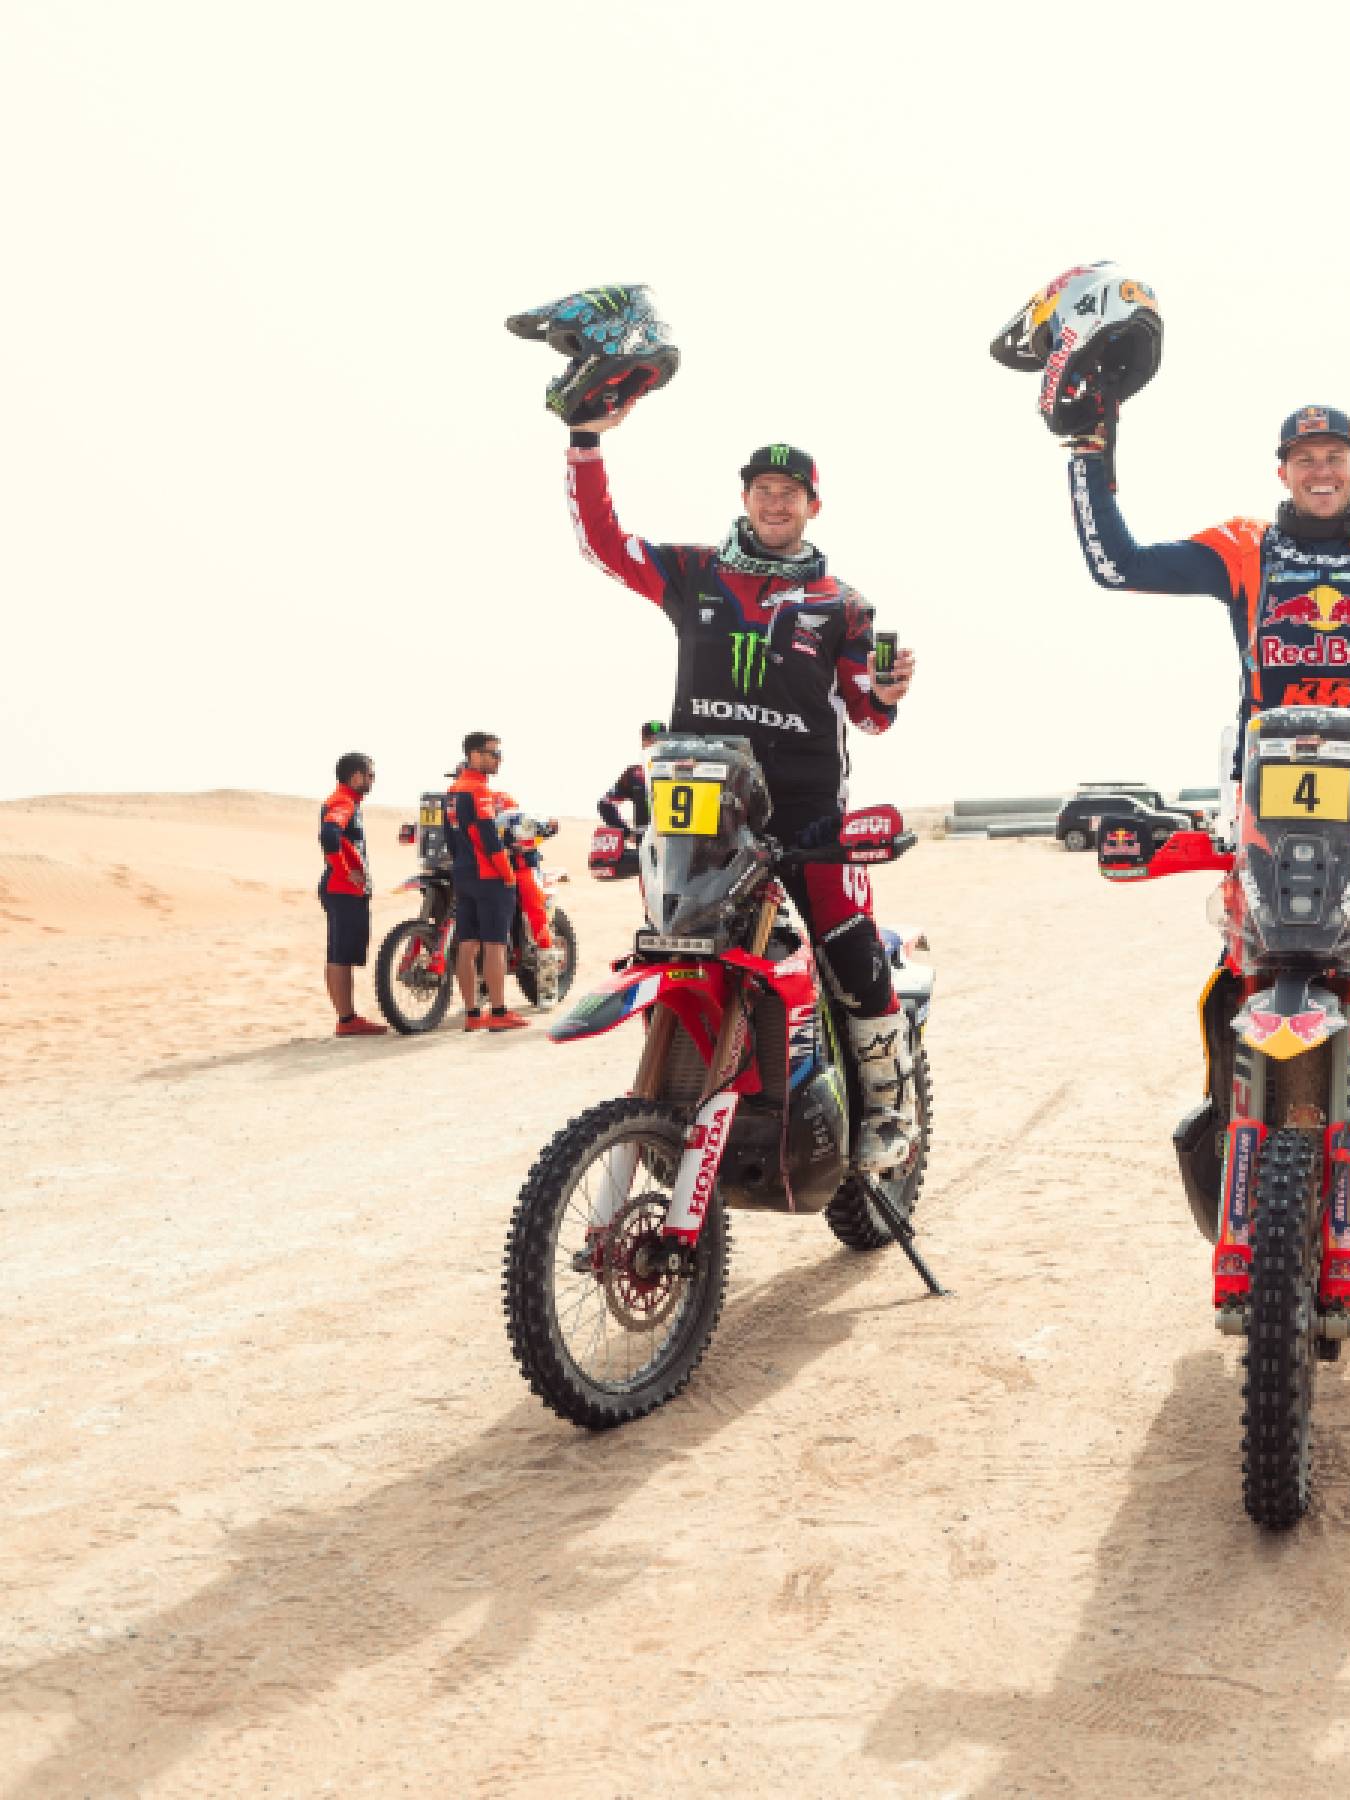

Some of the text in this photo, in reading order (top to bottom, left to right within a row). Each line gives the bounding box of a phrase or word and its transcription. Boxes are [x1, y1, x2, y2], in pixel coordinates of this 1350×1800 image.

[1262, 633, 1324, 668] Red
[691, 698, 809, 733] HONDA
[670, 784, 695, 829] 9
[1292, 772, 1320, 813] 4
[843, 816, 891, 836] GIVI
[688, 1107, 729, 1216] HONDA
